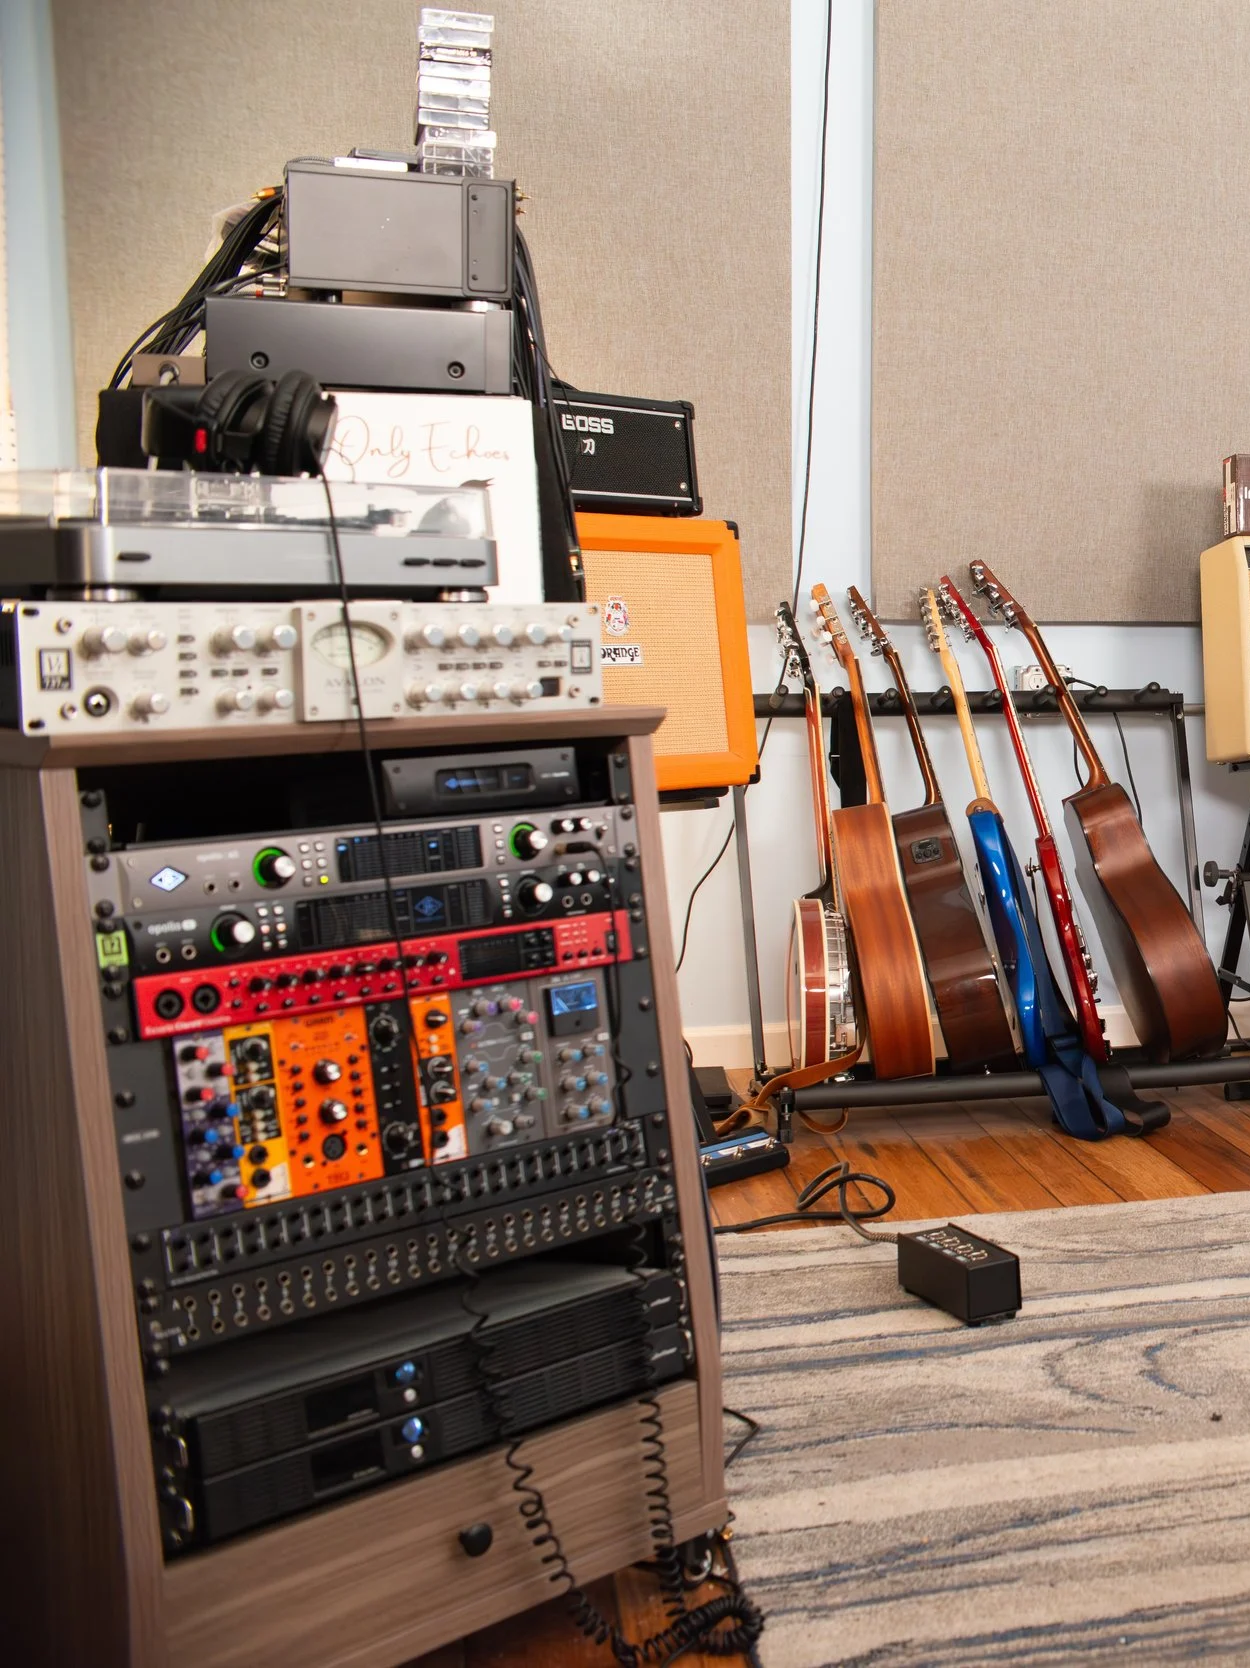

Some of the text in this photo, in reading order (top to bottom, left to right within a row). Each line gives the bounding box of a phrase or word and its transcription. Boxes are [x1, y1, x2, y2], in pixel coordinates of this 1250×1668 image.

[561, 413, 614, 434] BOSS
[332, 415, 510, 482] Only Echoes
